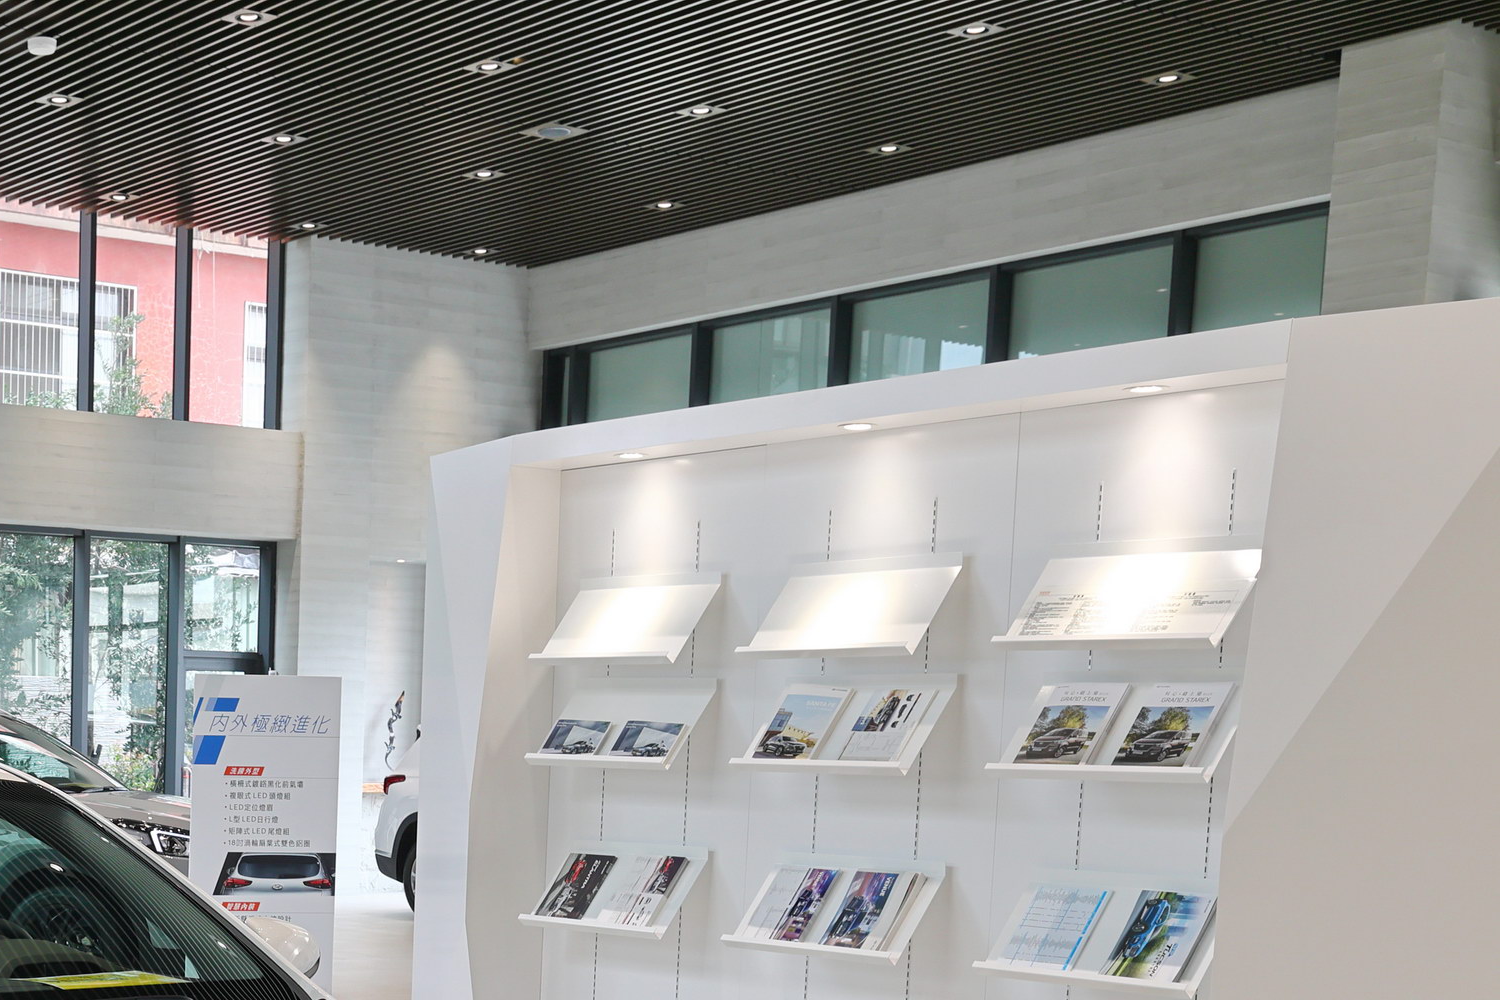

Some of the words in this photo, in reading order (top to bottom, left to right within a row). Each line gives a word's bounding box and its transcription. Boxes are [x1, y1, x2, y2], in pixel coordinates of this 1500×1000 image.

[209, 713, 331, 734] 內外極緻進化
[880, 876, 893, 897] VENUE
[1149, 943, 1173, 977] TUCSON
